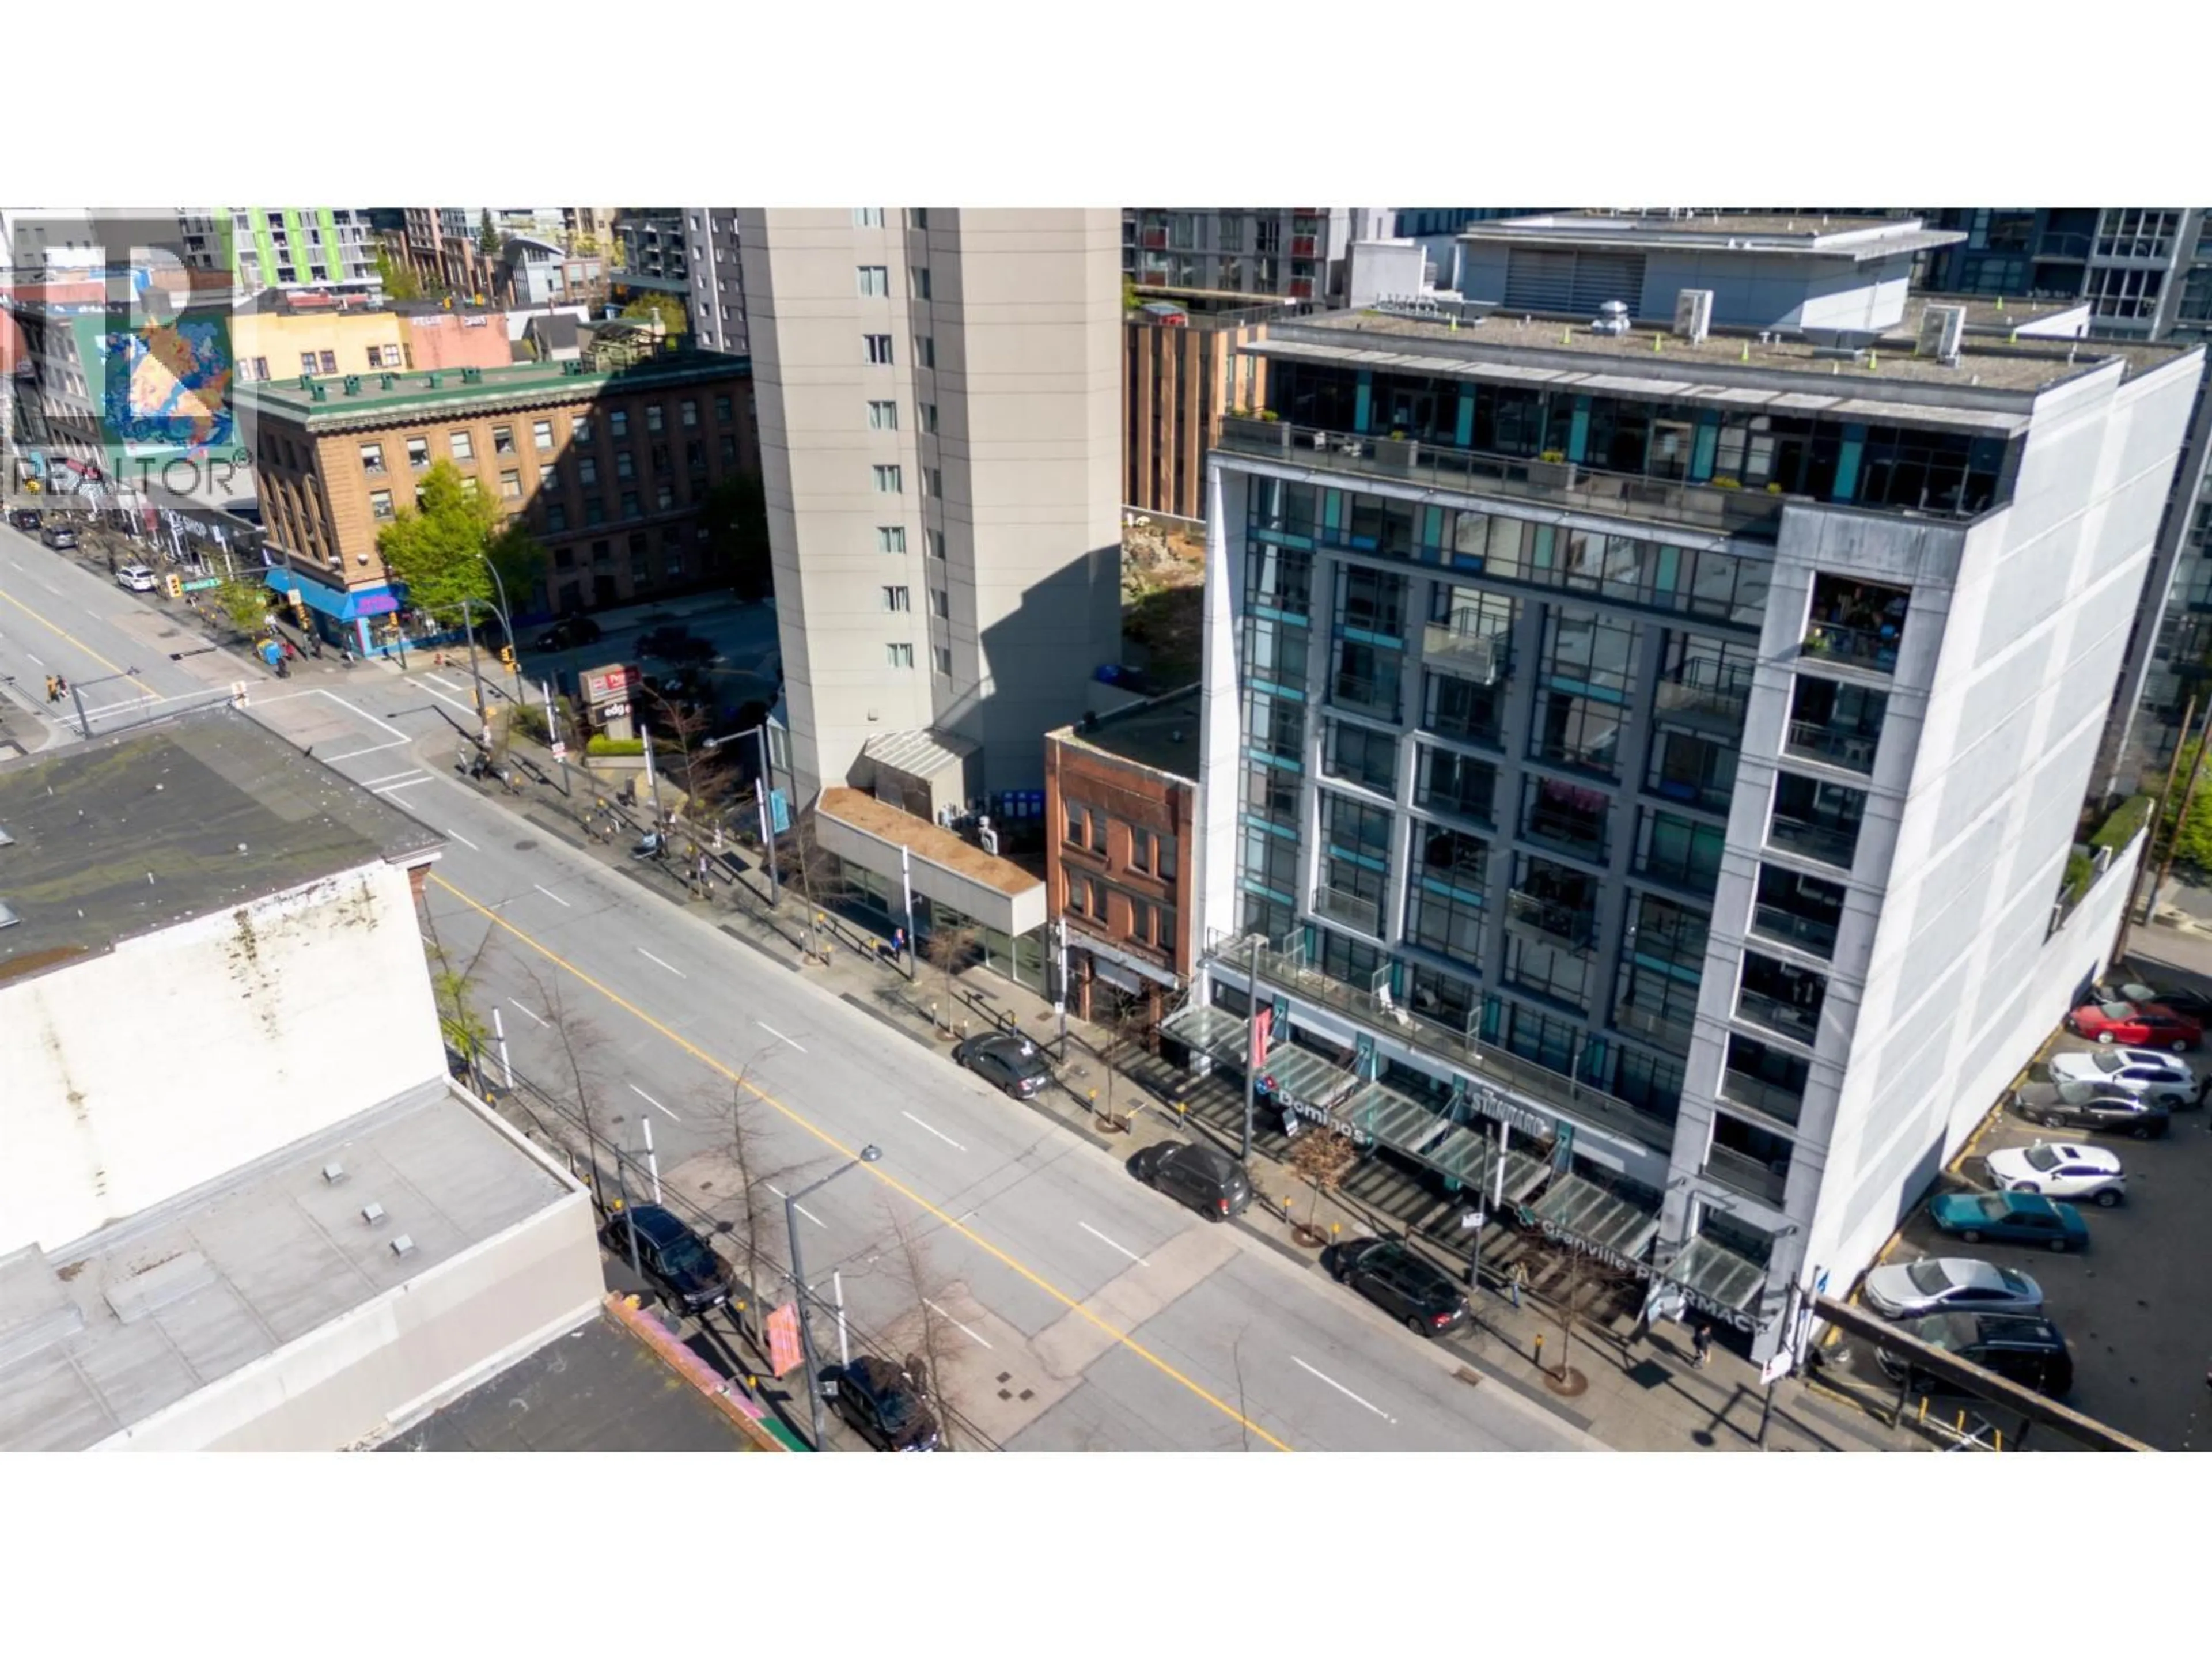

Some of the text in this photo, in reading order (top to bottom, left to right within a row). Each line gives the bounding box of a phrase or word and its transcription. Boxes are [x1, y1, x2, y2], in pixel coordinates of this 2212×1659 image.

[1278, 1088, 1365, 1145] Domino's
[1541, 1219, 1771, 1336] Granville PHARMACY
